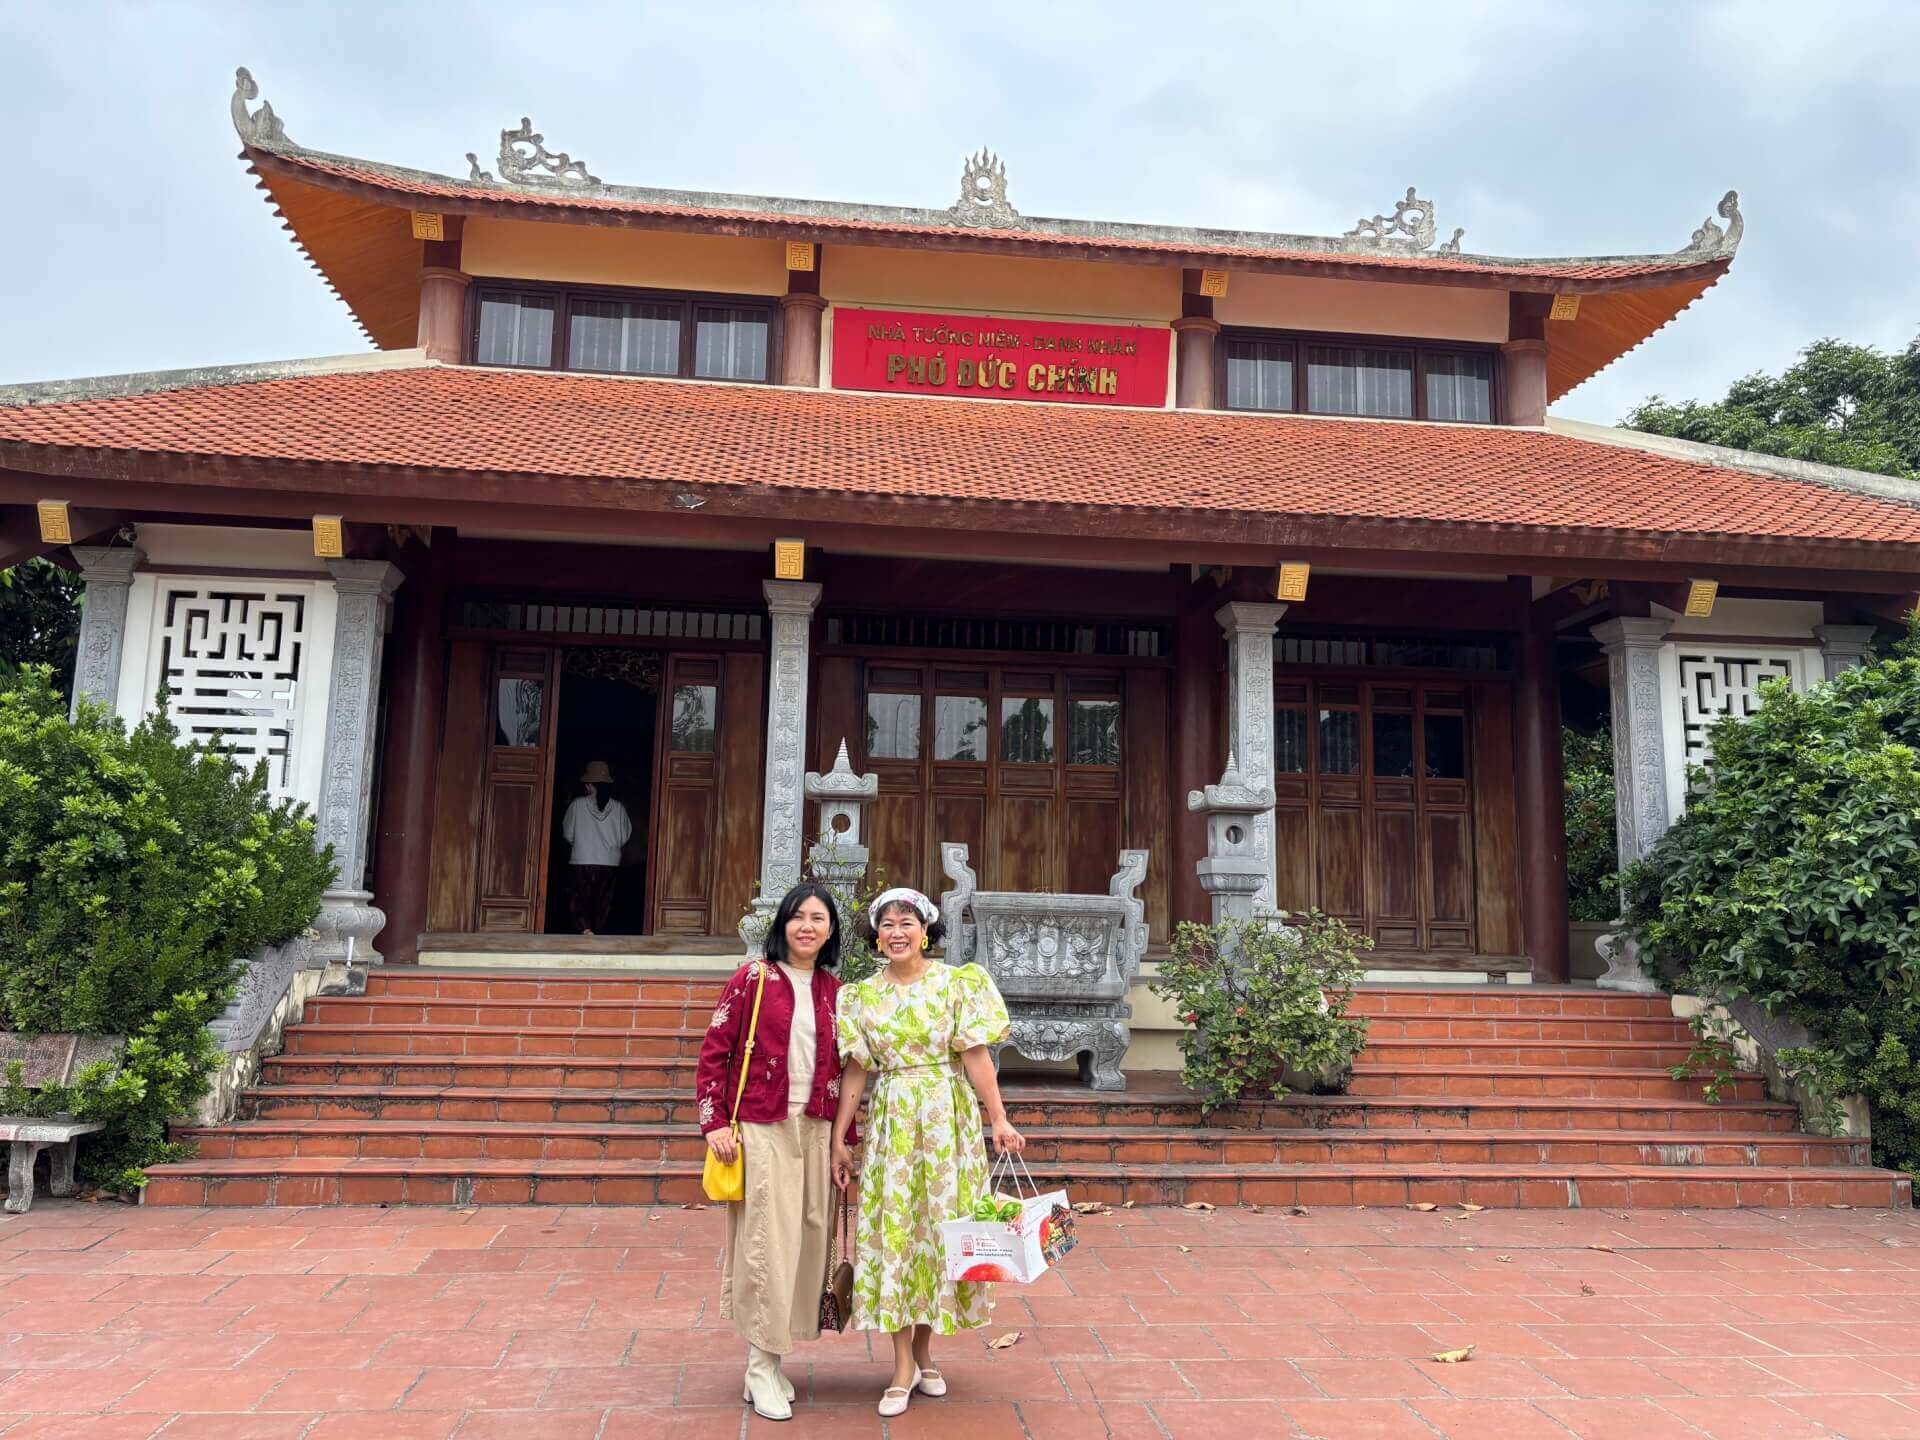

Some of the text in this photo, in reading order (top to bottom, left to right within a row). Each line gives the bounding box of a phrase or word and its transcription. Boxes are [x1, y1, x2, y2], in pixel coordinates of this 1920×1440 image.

[867, 320, 906, 341] NHÀ
[1033, 336, 1082, 352] DANH
[1028, 358, 1118, 395] CHÍNH
